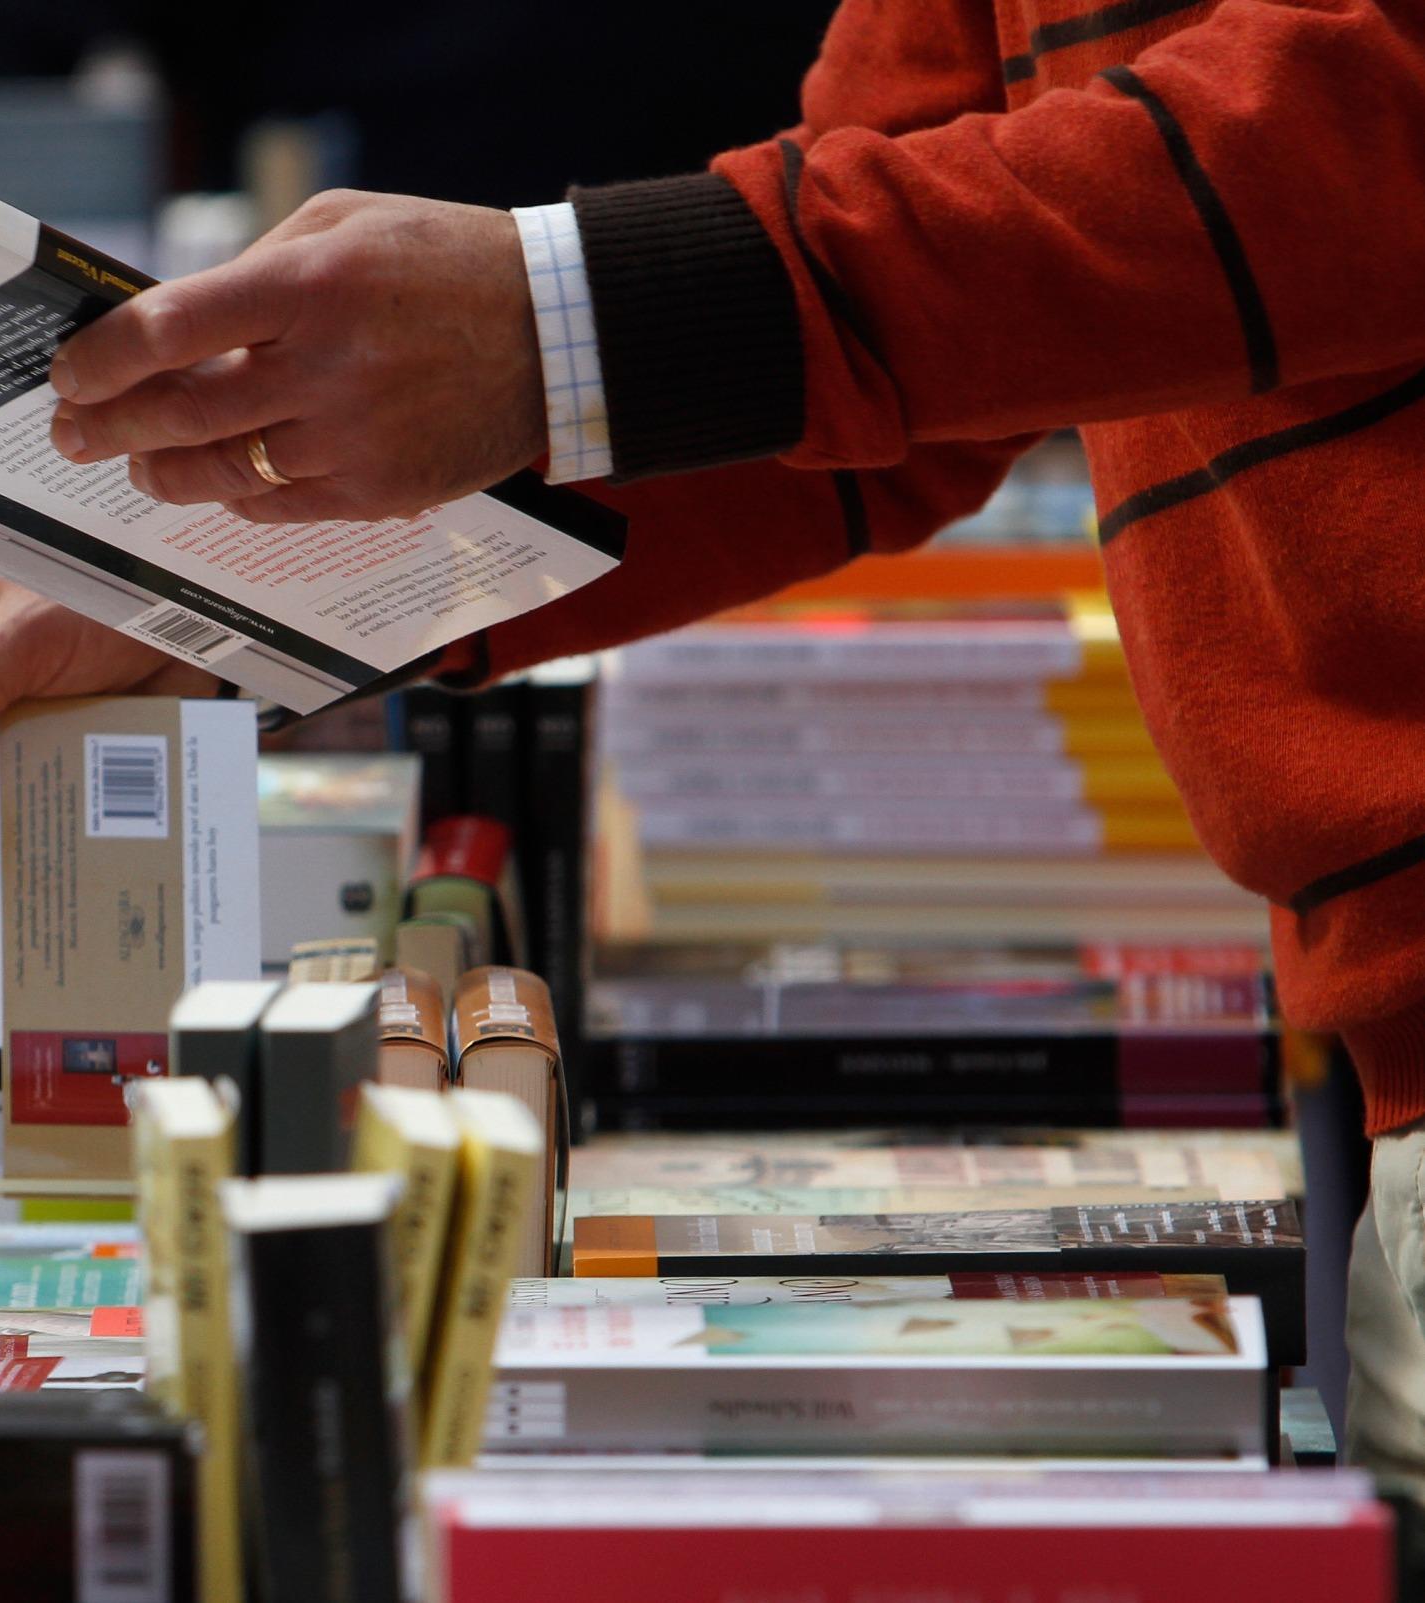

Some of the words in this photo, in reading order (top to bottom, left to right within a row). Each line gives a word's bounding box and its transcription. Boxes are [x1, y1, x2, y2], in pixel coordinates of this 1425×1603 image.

[9, 304, 45, 326] político
[35, 312, 61, 325] Con
[12, 361, 23, 370] el
[0, 383, 15, 392] de
